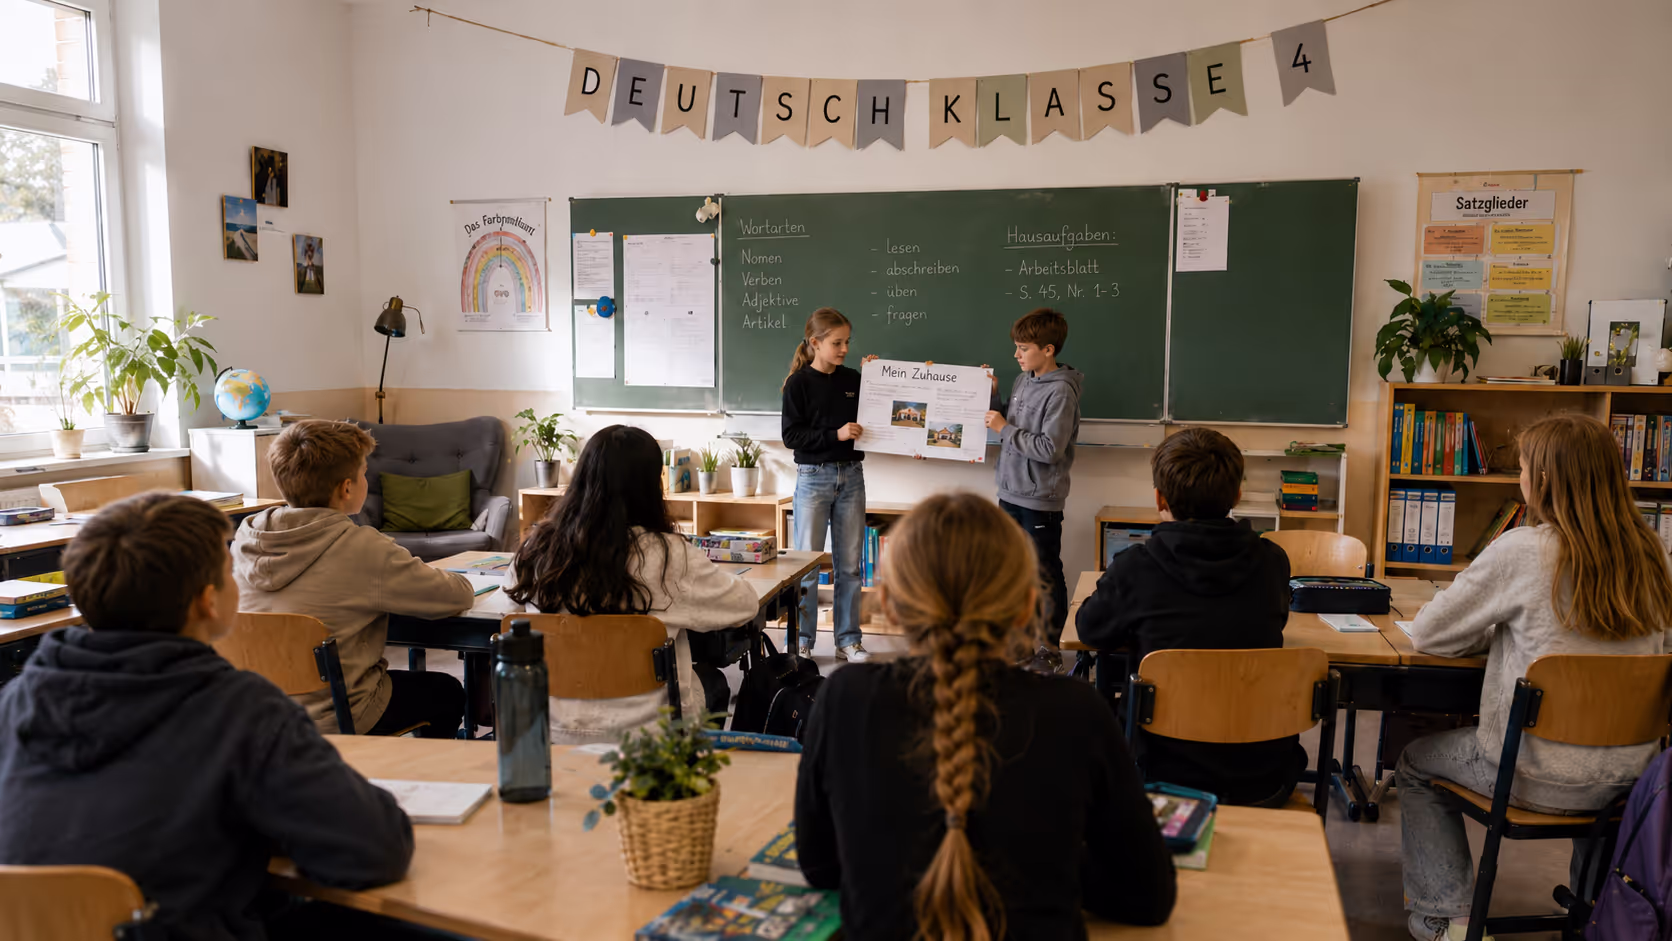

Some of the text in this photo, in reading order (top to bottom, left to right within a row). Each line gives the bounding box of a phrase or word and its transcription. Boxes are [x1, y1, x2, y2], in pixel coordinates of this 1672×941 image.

[581, 42, 1312, 125] DEUTSCH KLASSE 4
[1455, 195, 1529, 213] Satzglieder
[464, 220, 481, 236] Das
[740, 218, 806, 235] Wortarten
[886, 238, 920, 254] lesen
[1007, 224, 1116, 251] Hausaufgaben:
[741, 249, 783, 265] Nomen
[886, 260, 960, 276] abschreiben
[1018, 259, 1100, 276] Arbeitsblatt
[742, 271, 782, 286] Verben
[886, 284, 917, 298] üben
[1019, 284, 1032, 300] S.
[1038, 284, 1061, 301] 45,
[1067, 283, 1085, 298] Nr.
[742, 292, 799, 312] Adjektive
[742, 314, 787, 329] Artikel
[886, 305, 927, 326] fragen
[881, 365, 957, 383] Mein Zuhause
